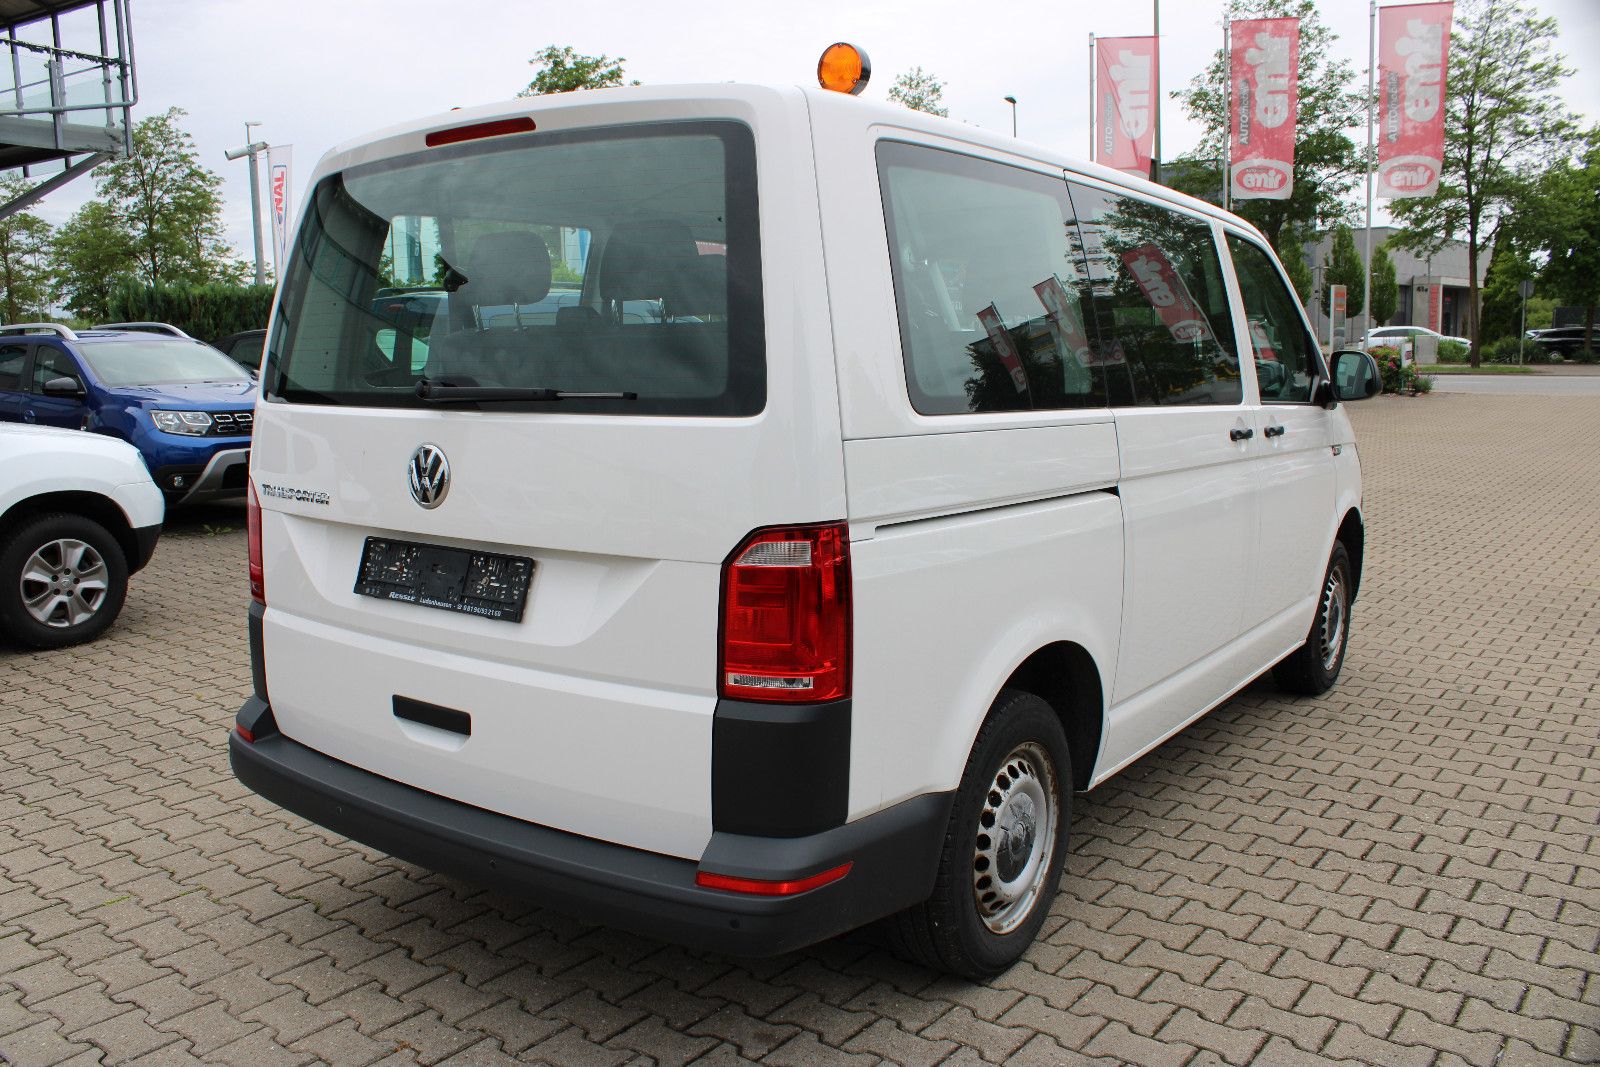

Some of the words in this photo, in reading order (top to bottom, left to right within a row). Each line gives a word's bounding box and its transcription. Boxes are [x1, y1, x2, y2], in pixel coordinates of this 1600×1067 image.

[1109, 50, 1150, 140] emir
[1245, 32, 1290, 128] emir
[1394, 19, 1443, 122] emir
[1243, 169, 1282, 188] emir
